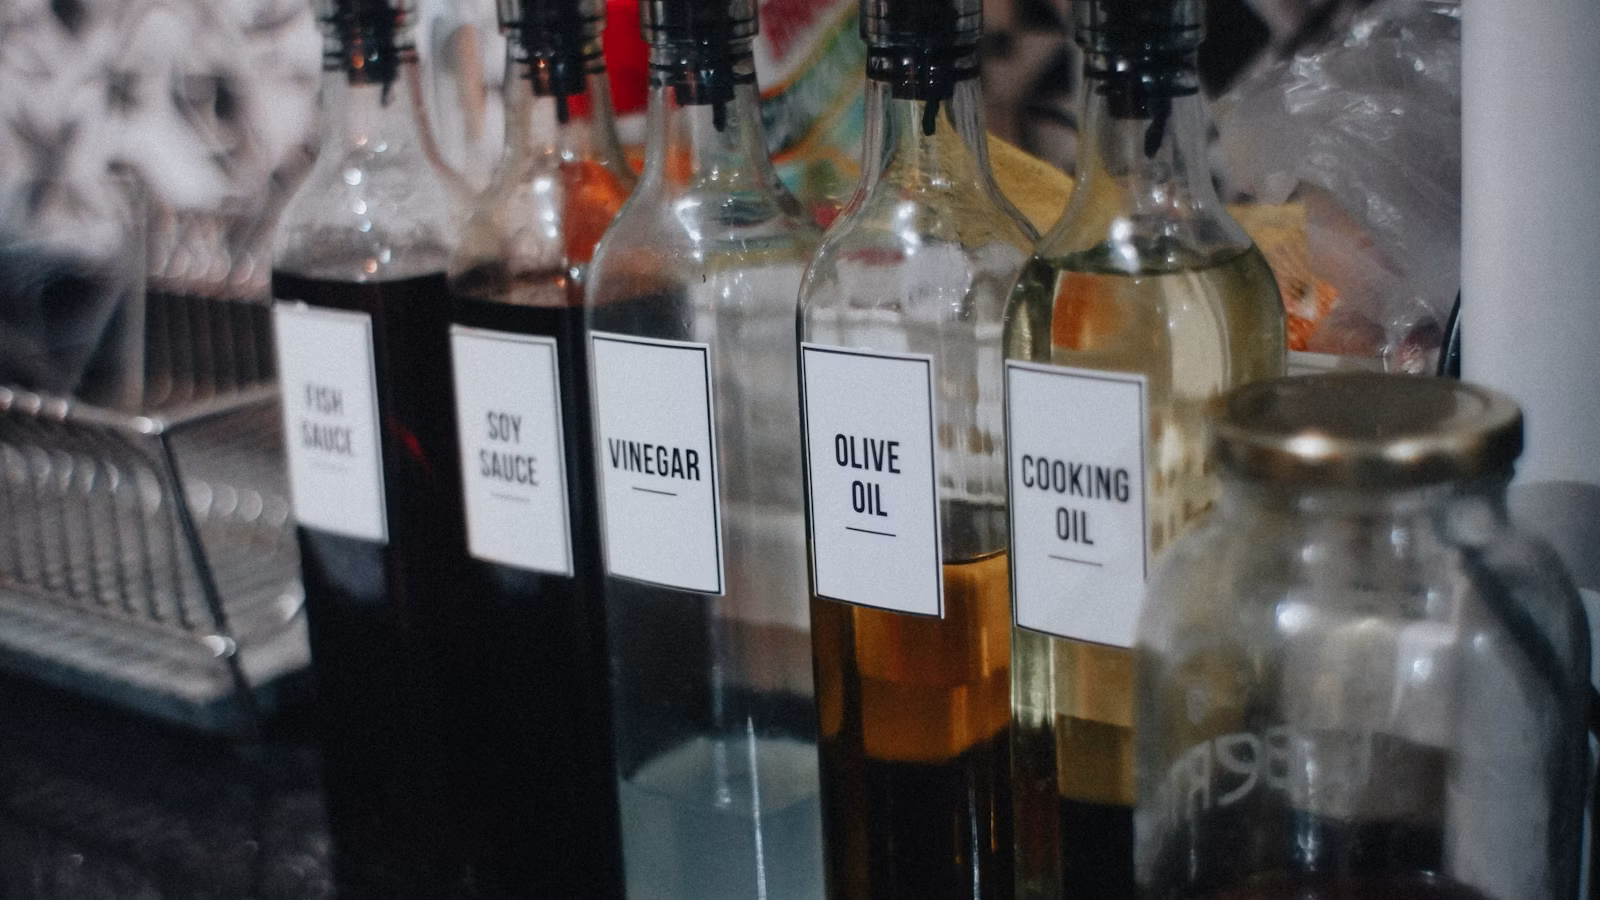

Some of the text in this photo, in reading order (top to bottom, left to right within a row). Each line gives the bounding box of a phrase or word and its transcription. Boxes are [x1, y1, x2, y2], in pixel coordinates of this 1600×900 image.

[304, 382, 344, 416] FISH
[302, 420, 353, 457] SAUCE
[487, 411, 522, 443] SOY
[480, 449, 539, 486] SAUCE
[608, 437, 702, 482] VINEGAR
[835, 434, 902, 475] OLIVE
[1022, 455, 1130, 503] COOKING
[852, 481, 889, 518] OIL
[1057, 507, 1094, 545] OIL
